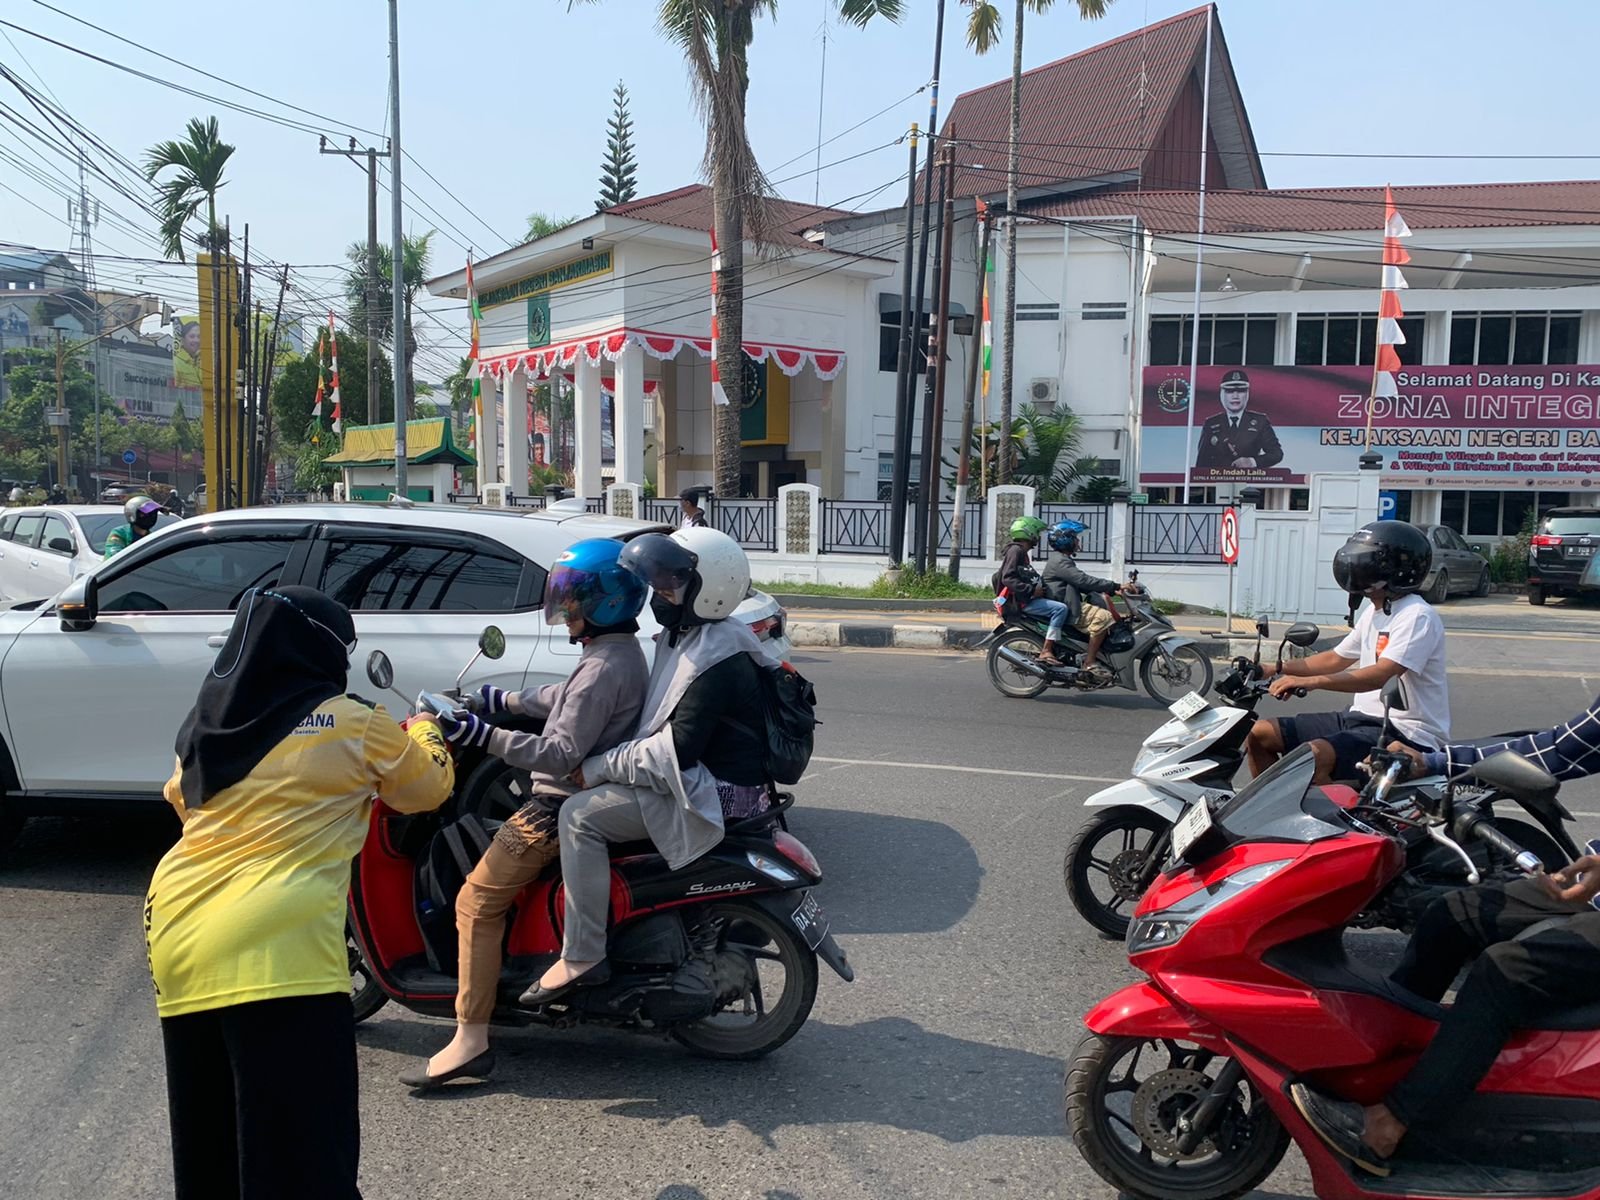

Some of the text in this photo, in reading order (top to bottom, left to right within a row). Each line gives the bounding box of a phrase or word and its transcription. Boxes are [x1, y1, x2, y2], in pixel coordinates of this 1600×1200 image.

[1397, 372, 1472, 387] Selamat
[1478, 372, 1544, 390] Datang
[1551, 372, 1570, 387] Di
[1337, 394, 1600, 419] ZONA INTEG
[1320, 428, 1461, 447] KEJAKSAAN
[1467, 429, 1560, 447] NEGERI
[1445, 451, 1495, 462] Wilayah
[1390, 461, 1400, 471] &
[1403, 461, 1451, 472] Wilayah
[1379, 496, 1395, 517] P
[1225, 517, 1233, 553] P
[1161, 766, 1191, 777] HONDA
[686, 880, 756, 896] Scoopy
[795, 912, 811, 931] DA
